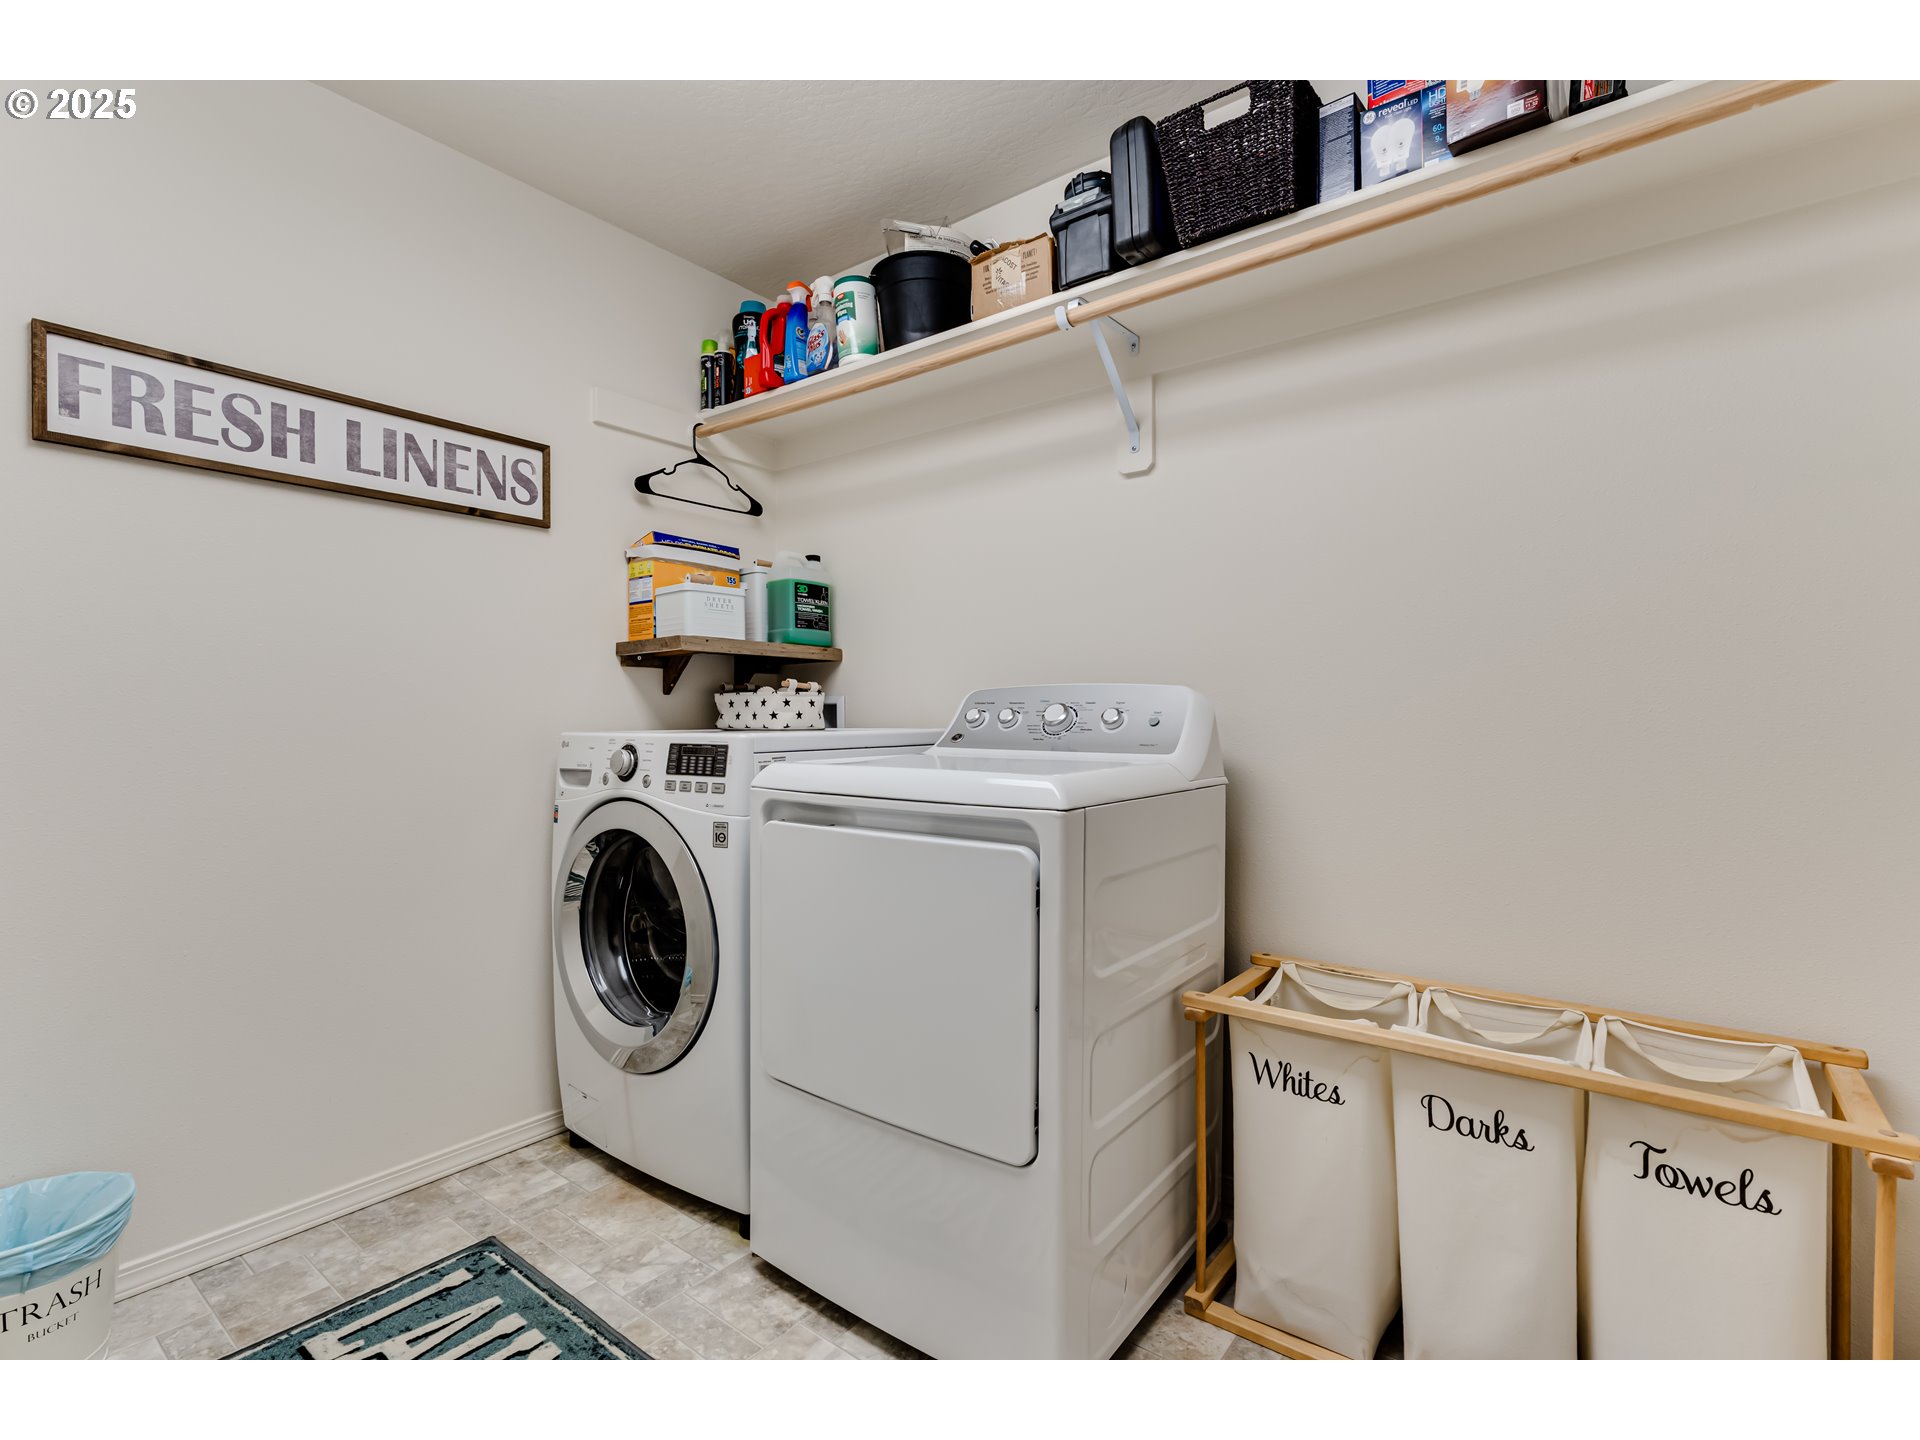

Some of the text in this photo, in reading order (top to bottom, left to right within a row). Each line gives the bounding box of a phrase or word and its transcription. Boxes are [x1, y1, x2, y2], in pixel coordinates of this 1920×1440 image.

[1378, 98, 1408, 118] reveal
[1407, 98, 1418, 107] LED
[56, 352, 539, 507] FRESH LINENS
[726, 576, 737, 586] 155
[796, 584, 809, 593] 3D
[704, 601, 735, 610] SHEETS
[706, 596, 732, 604] DRYER
[1248, 1051, 1346, 1106] Whites
[1420, 1094, 1536, 1153] Darks
[1629, 1140, 1783, 1216] Towels
[0, 1268, 102, 1333] TRASH
[27, 1311, 80, 1343] BUCKET
